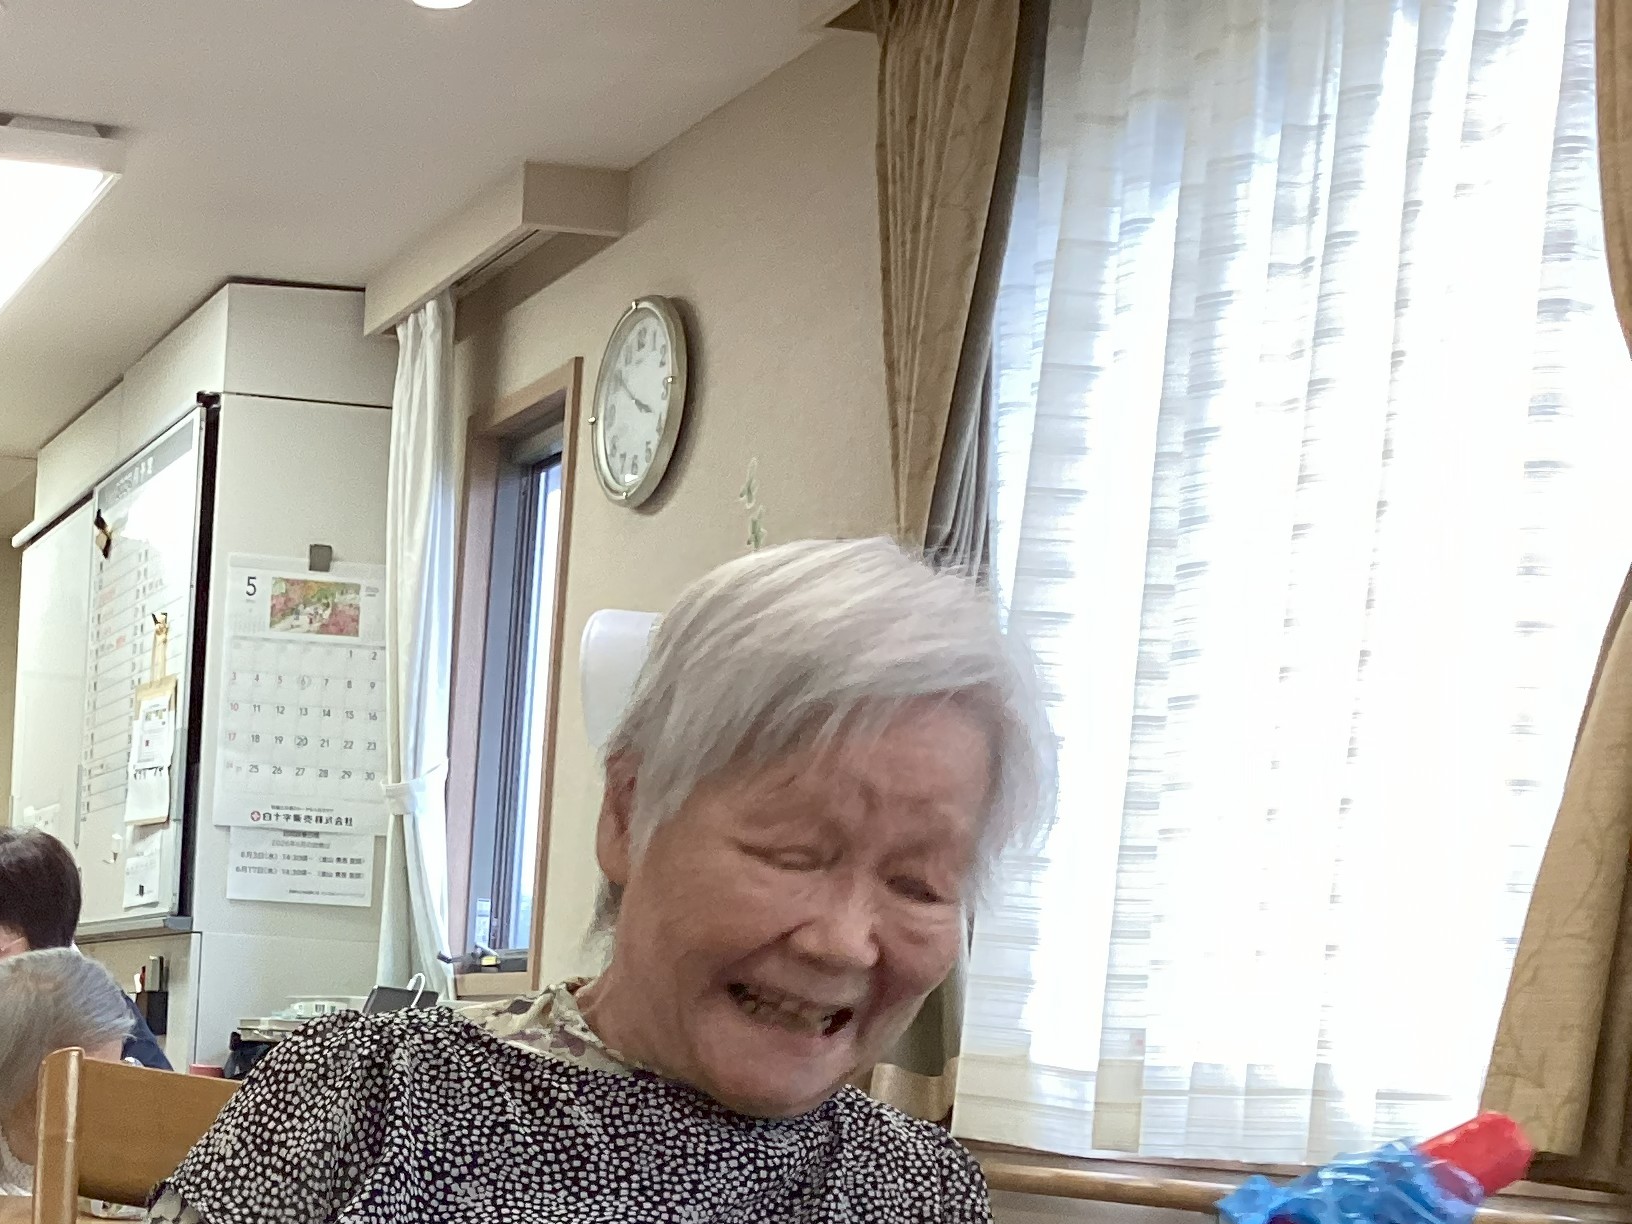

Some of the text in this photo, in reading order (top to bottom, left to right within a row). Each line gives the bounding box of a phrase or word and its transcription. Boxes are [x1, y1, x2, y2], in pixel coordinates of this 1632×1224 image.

[660, 344, 666, 368] 2
[645, 441, 652, 463] 5
[620, 453, 627, 474] 7
[631, 455, 639, 475] 6
[245, 576, 257, 597] 5
